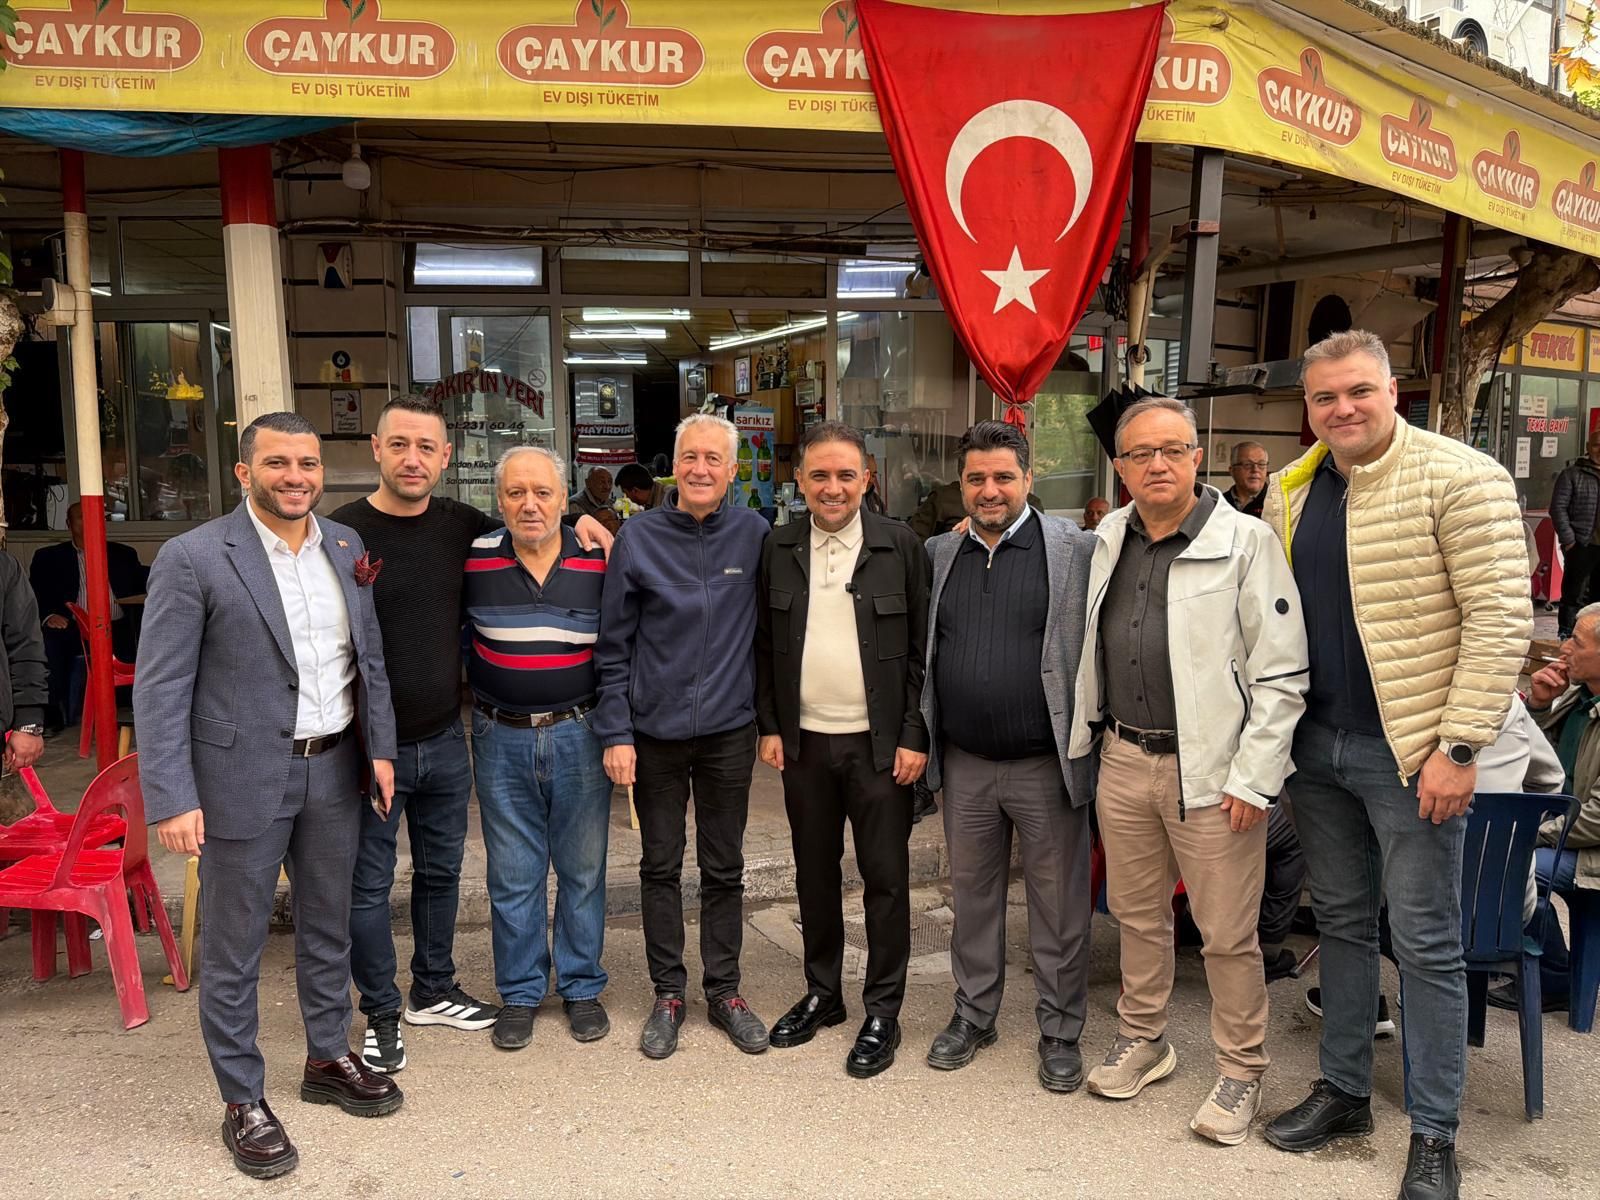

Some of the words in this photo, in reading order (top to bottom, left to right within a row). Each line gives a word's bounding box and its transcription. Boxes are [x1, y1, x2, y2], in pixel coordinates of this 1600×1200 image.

[6, 21, 182, 60] ÇAYKUR
[263, 29, 436, 68] ÇAYKUR
[515, 36, 685, 75] ÇAYKUR
[763, 45, 872, 83] ÇAYK
[35, 75, 54, 88] EV
[58, 76, 86, 91] DIŞI
[92, 75, 156, 90] TÜKETİM
[1152, 56, 1219, 93] KUR
[291, 82, 311, 95] EV
[314, 83, 342, 98] DIŞI
[348, 82, 411, 98] TÜKETİM
[543, 90, 562, 104] EV
[566, 92, 594, 108] DIŞI
[597, 91, 659, 107] TÜKETİM
[788, 99, 806, 112] EV
[810, 100, 836, 114] DIŞI
[840, 98, 878, 113] TÜKE
[1146, 106, 1196, 123] ÜKETİM
[1265, 80, 1354, 136] ÇAYKUR
[1281, 130, 1293, 142] EV
[1387, 123, 1453, 172] ÇAYKUR
[1392, 171, 1402, 182] EV
[1477, 160, 1535, 202] ÇAYKUR
[1530, 332, 1575, 362] TEKEL
[502, 373, 545, 420] YERİ
[489, 421, 505, 430] 60
[508, 421, 527, 430] 46
[736, 414, 772, 426] sarıkız
[1527, 417, 1548, 432] TEKEL
[446, 477, 489, 485] Salonumuz
